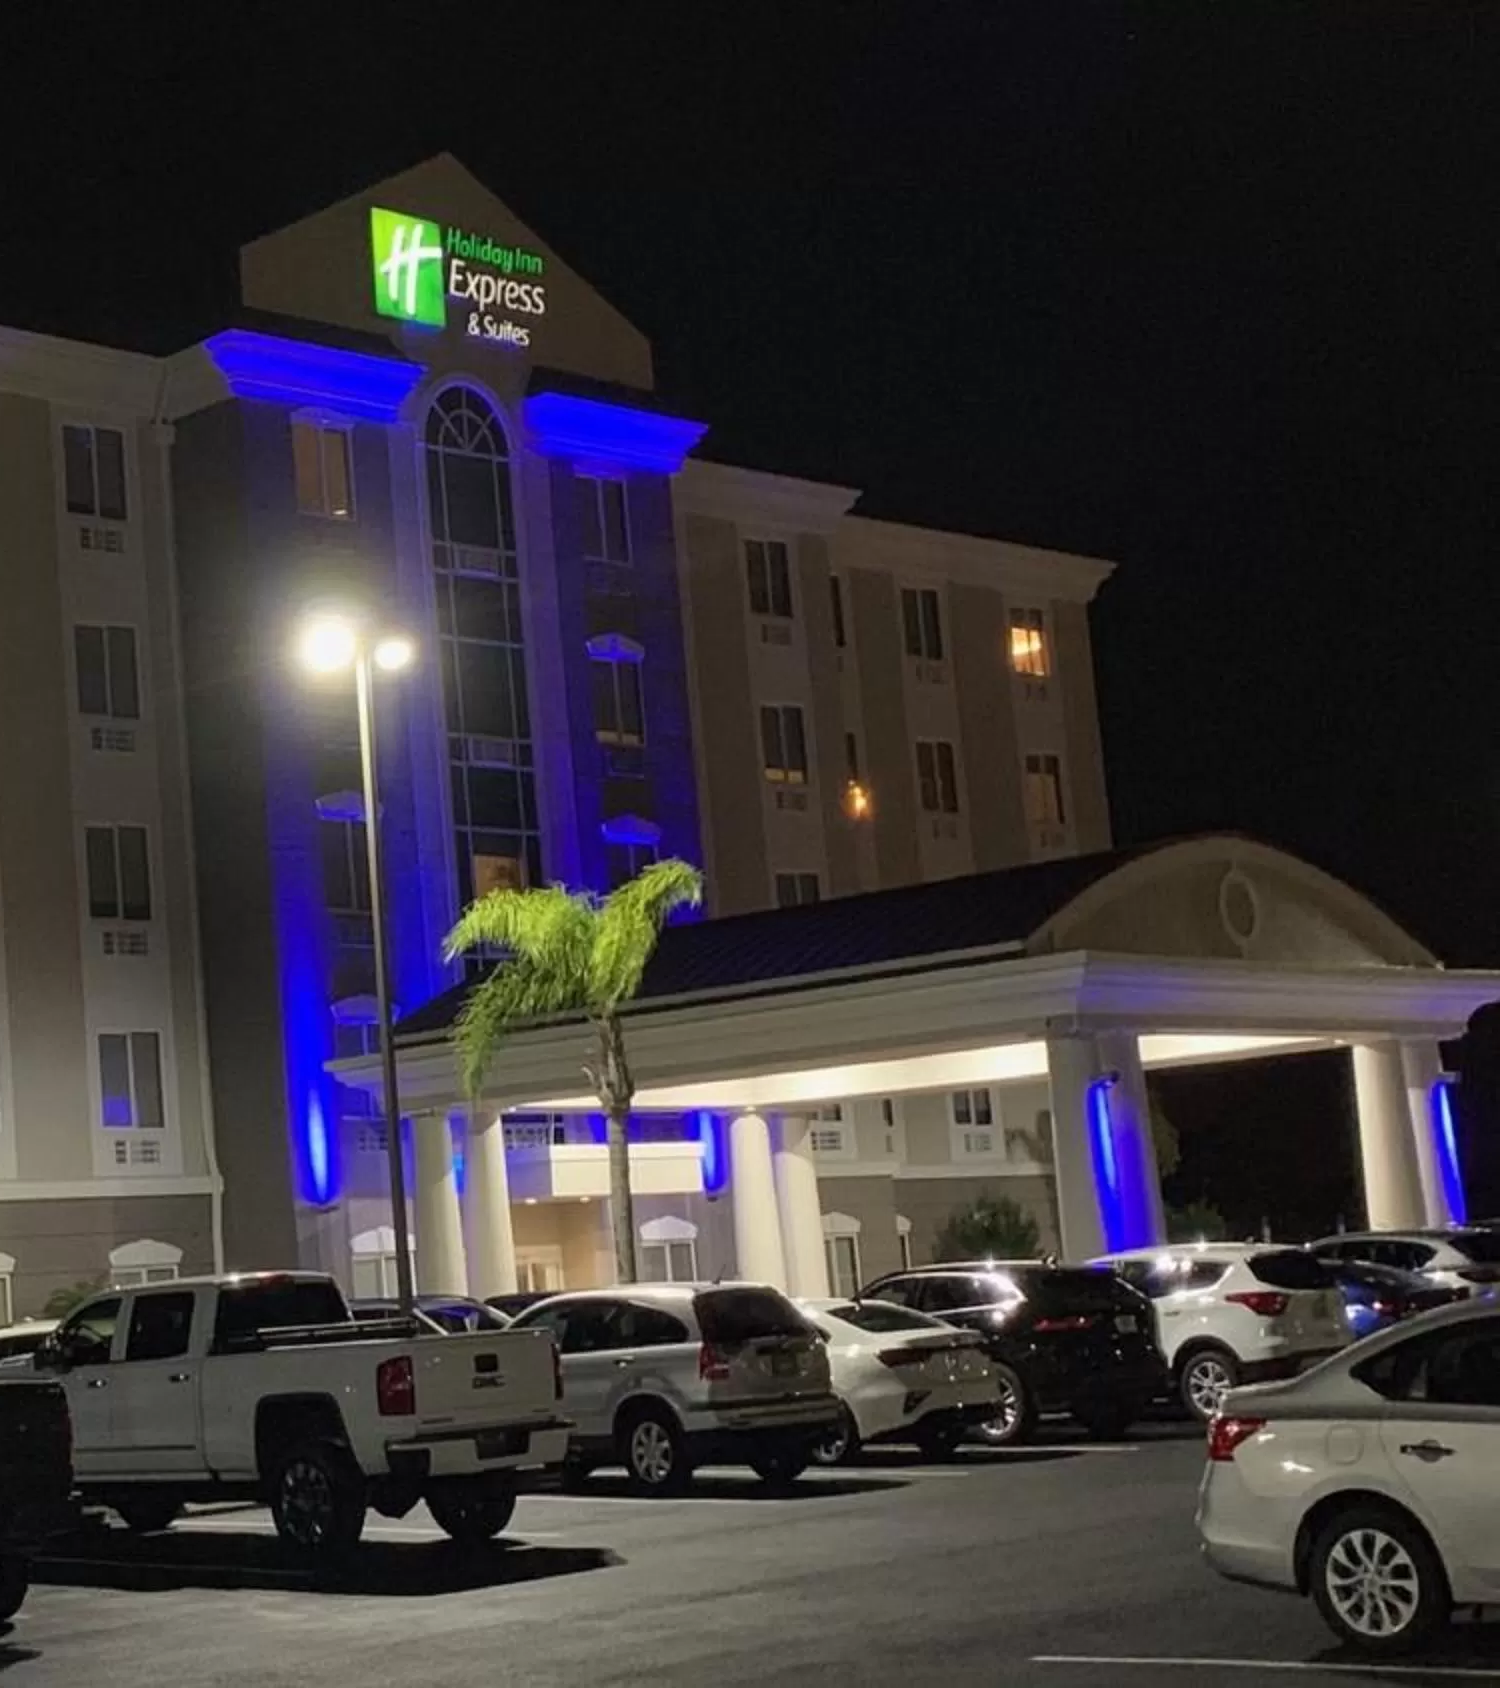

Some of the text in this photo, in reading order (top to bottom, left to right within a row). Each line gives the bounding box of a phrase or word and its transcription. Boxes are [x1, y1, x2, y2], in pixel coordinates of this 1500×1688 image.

[447, 227, 543, 275] Holiday Inn
[450, 258, 545, 315] Express
[467, 312, 531, 346] & Suites
